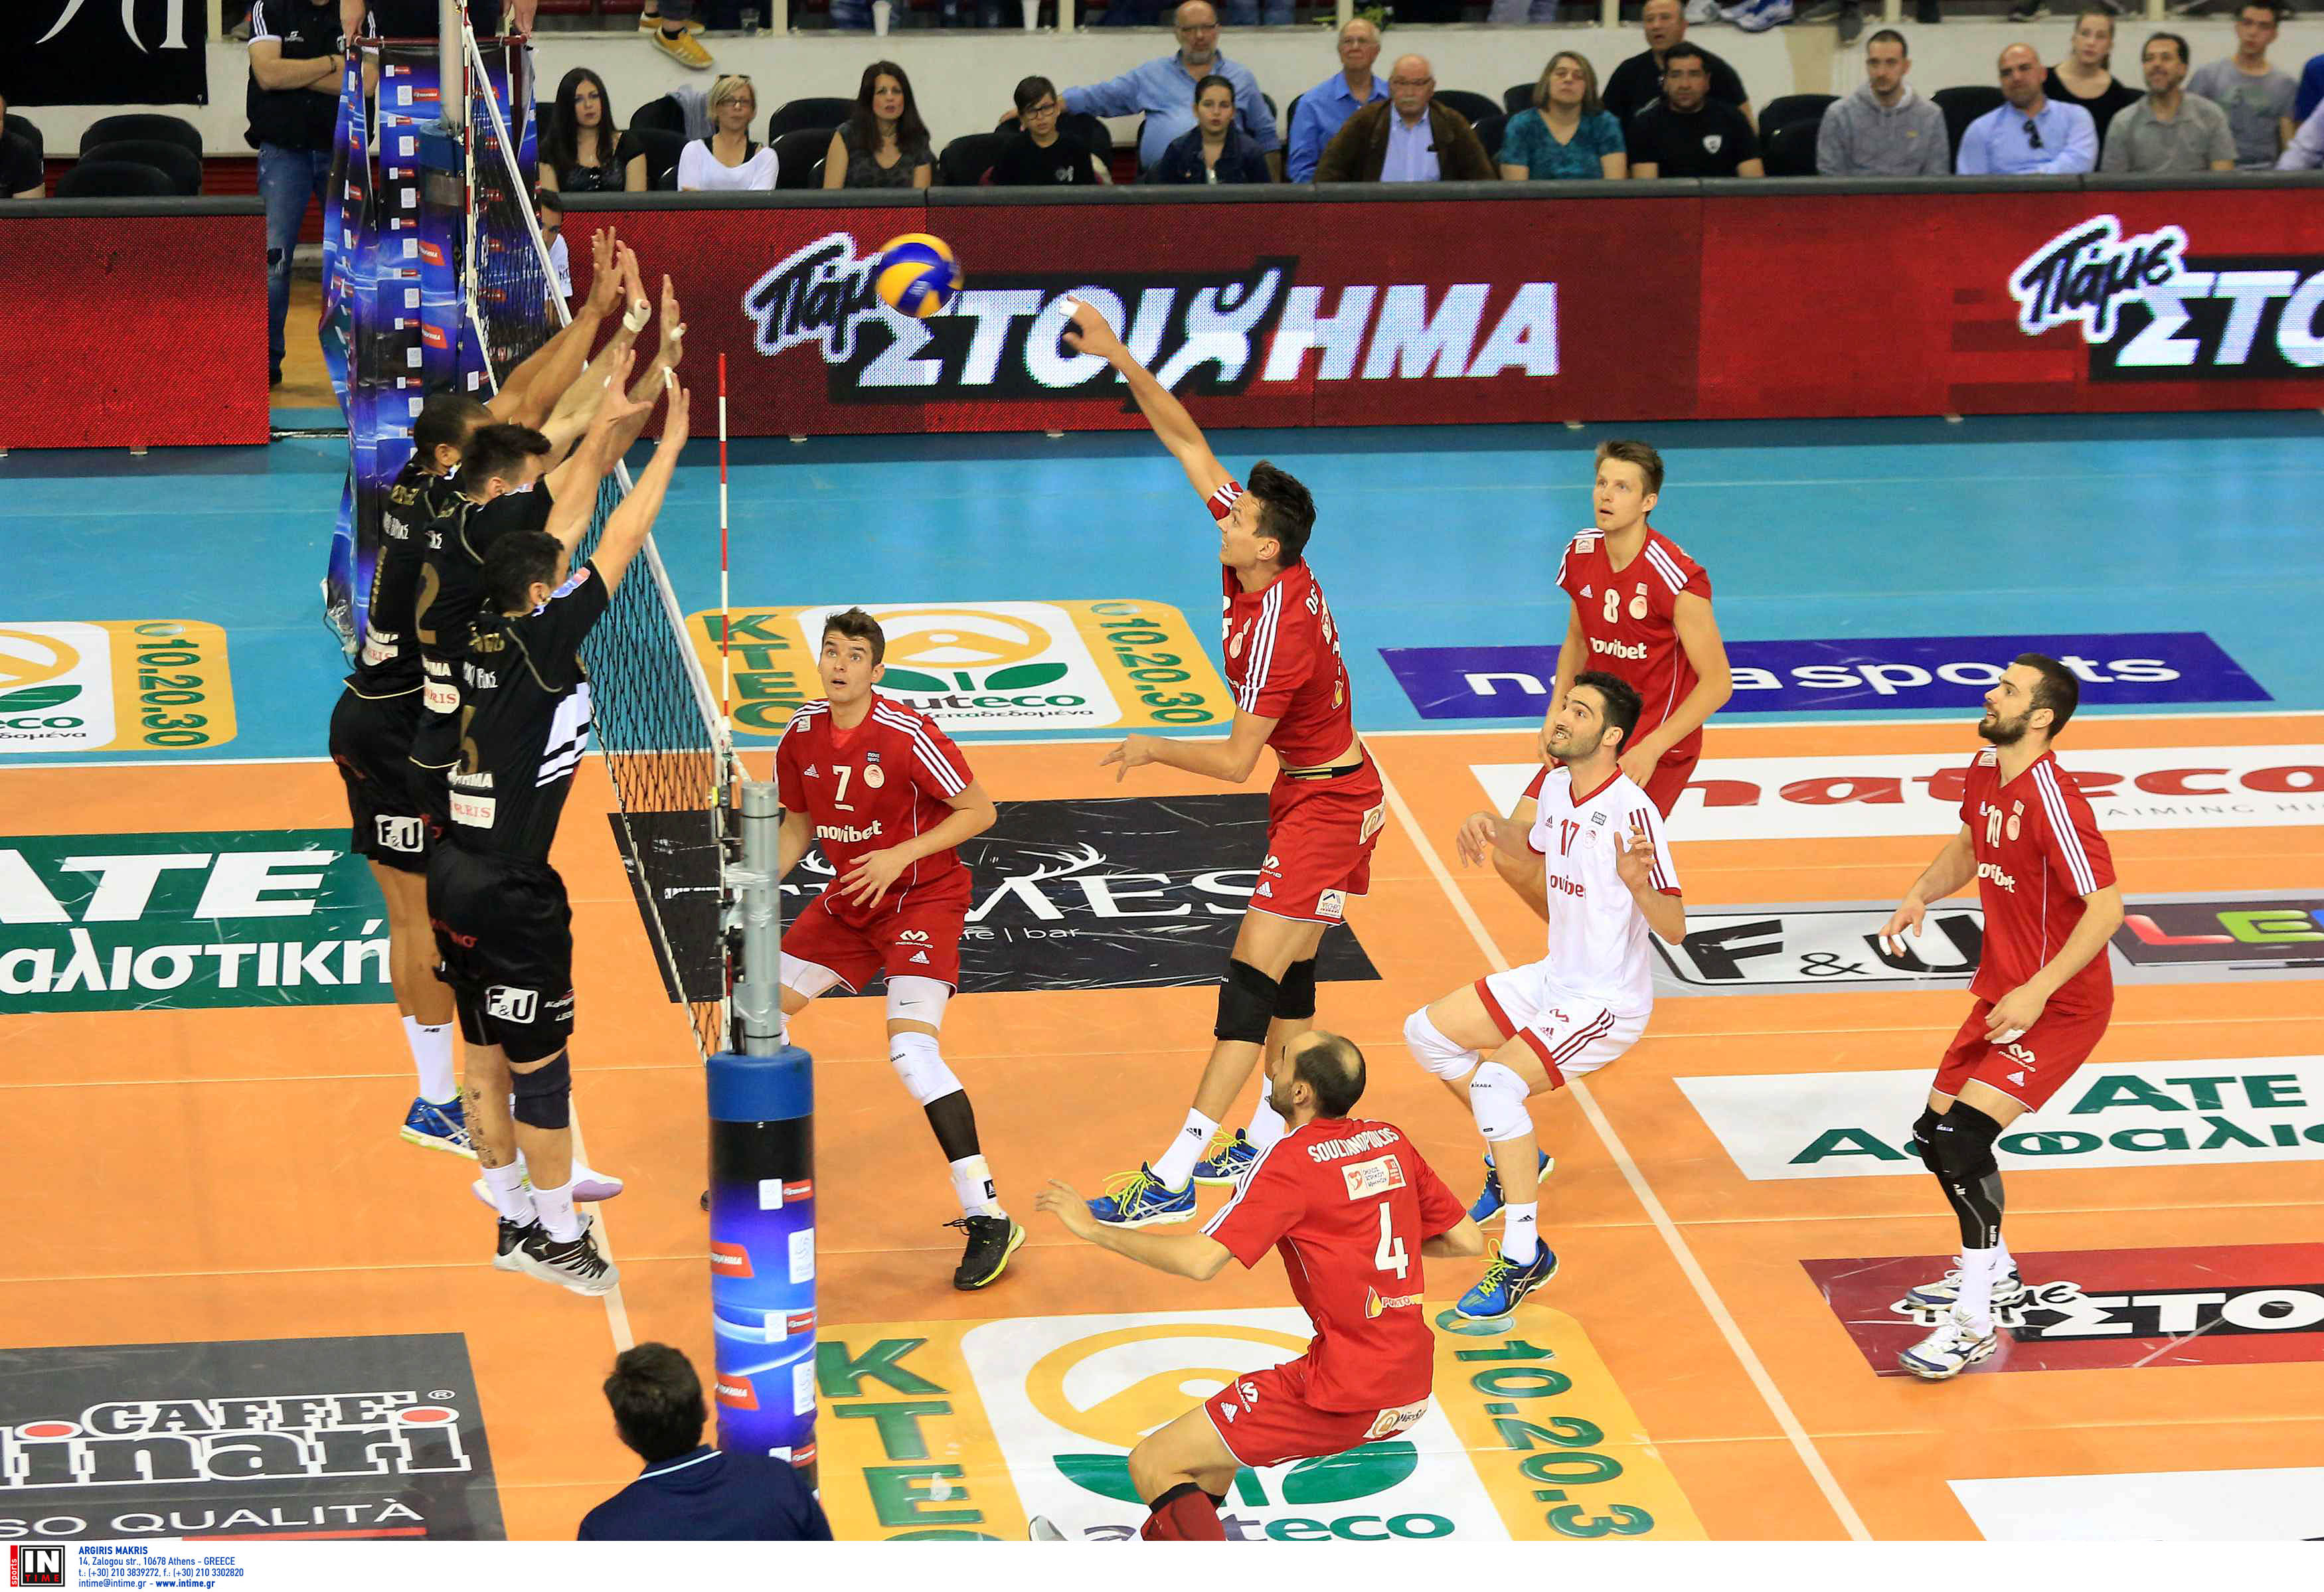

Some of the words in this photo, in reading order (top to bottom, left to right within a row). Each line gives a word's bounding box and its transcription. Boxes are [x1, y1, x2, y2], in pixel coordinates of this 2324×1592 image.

[746, 234, 886, 362] Πάμ
[1604, 588, 1621, 624] 8
[1590, 637, 1647, 659] ovibet
[1100, 618, 1214, 723] 10.20.30
[136, 639, 210, 747] 10.20.30
[904, 694, 1085, 709] uteco
[832, 765, 852, 801] 7
[2275, 797, 2324, 811] HI
[815, 820, 882, 843] novibet
[1560, 819, 1580, 858] 17
[1985, 805, 2003, 848] 10
[1023, 927, 1080, 939] bar
[2123, 909, 2324, 945] LE
[2069, 1074, 2307, 1115] ΑΤΕ
[1374, 1202, 1408, 1279] 4
[816, 1338, 1004, 1540] ΚΤΕ
[110, 1498, 425, 1532] QUALITÀ
